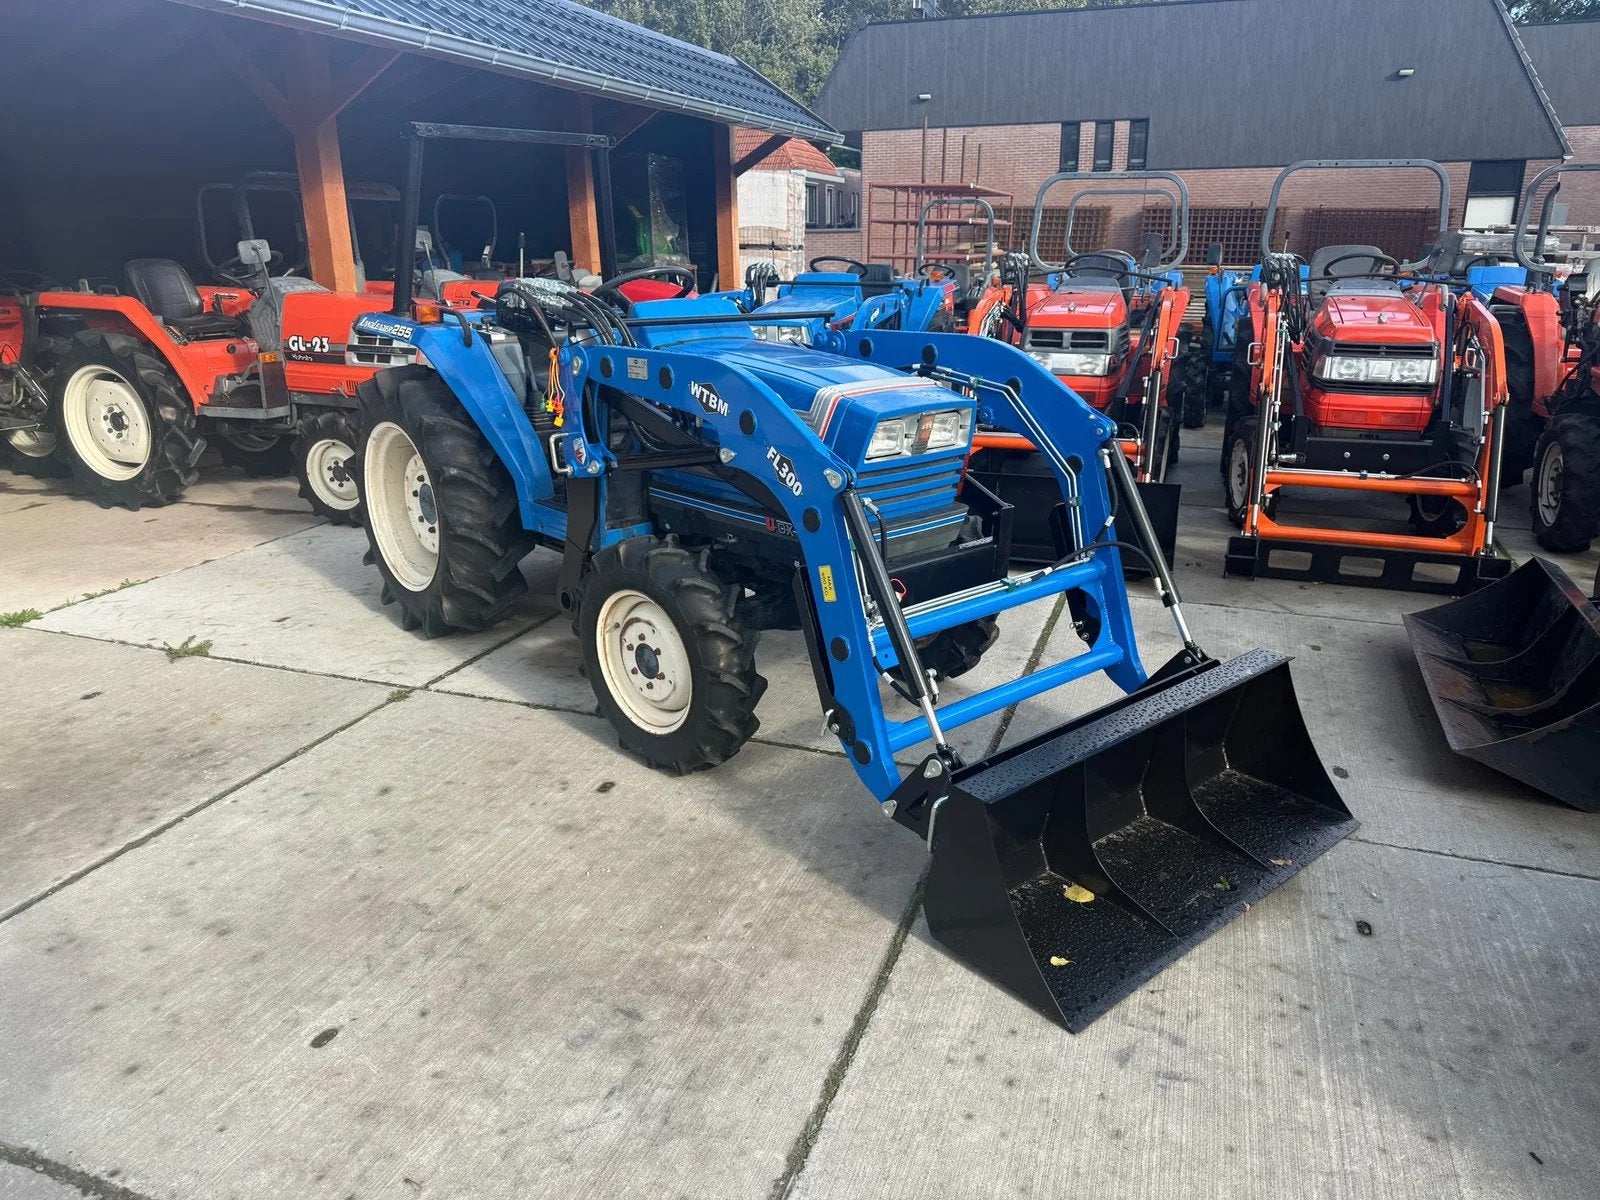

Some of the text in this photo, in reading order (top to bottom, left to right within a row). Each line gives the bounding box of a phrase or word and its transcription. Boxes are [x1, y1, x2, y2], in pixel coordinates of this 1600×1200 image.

[288, 335, 330, 353] GL-23
[690, 380, 729, 417] WTBM
[766, 446, 803, 496] FL300
